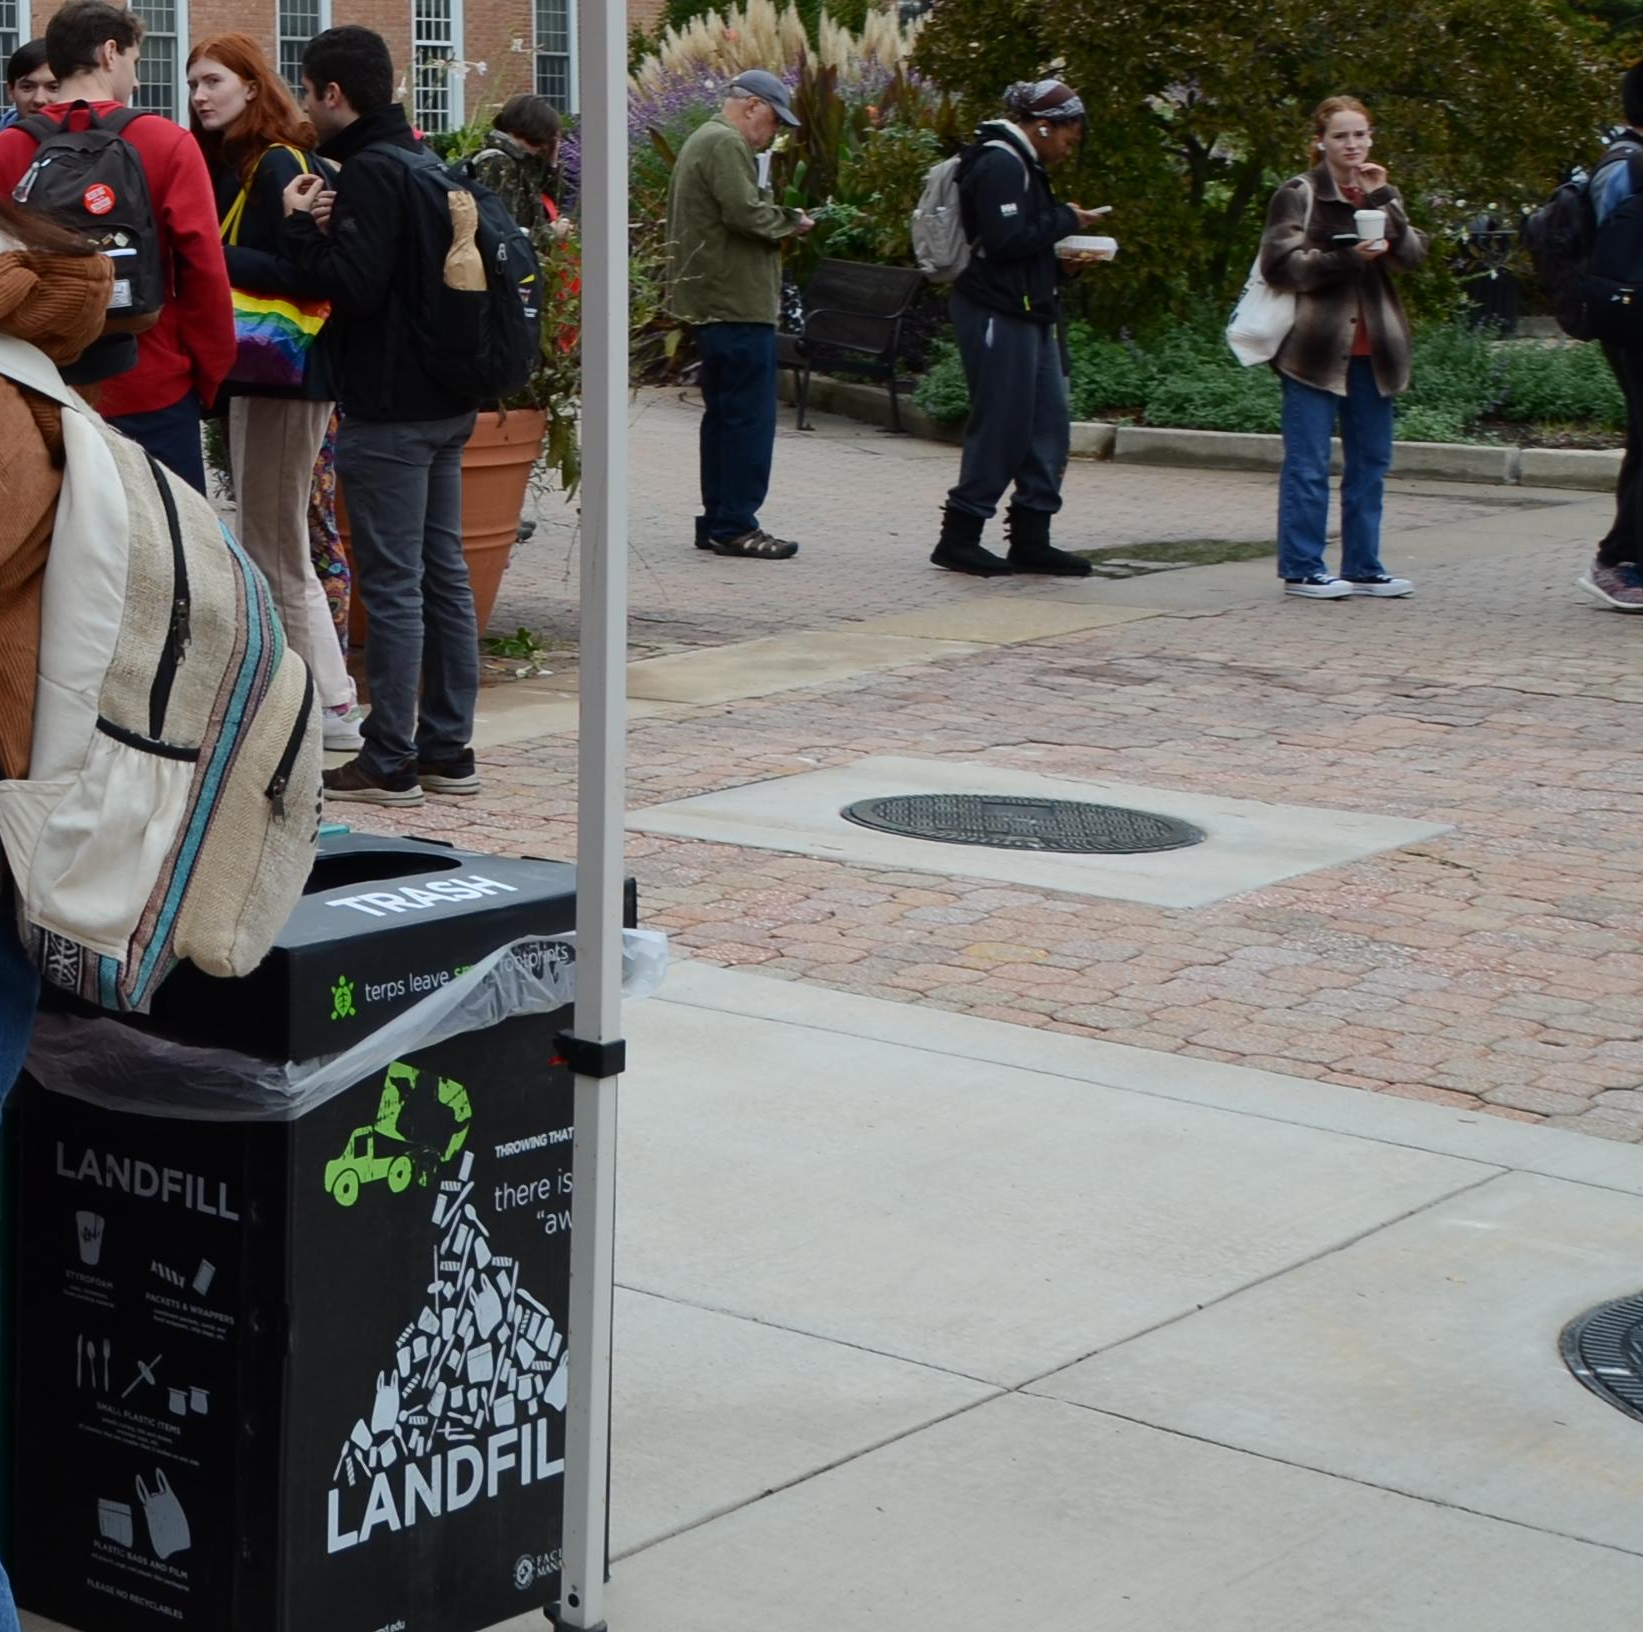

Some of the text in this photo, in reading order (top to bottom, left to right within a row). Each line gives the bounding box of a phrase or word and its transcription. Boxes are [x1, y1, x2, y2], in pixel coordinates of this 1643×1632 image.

[325, 875, 518, 917] TRASH
[365, 976, 405, 1002] terps
[409, 967, 449, 993] leave
[494, 1126, 573, 1159] THROWING THAT
[55, 1140, 240, 1222] LANDFILL
[494, 1167, 573, 1213] there is
[64, 1269, 115, 1289] STYROFOAM
[145, 1292, 182, 1311] PACKETS
[189, 1304, 236, 1326] WRAPPERS
[96, 1401, 182, 1436] SMALL PLASTIC ITEMS
[93, 1539, 189, 1579] PLASTIC BAGS AND FILM
[86, 1577, 184, 1620] PLEASE NO RECYCLABLES
